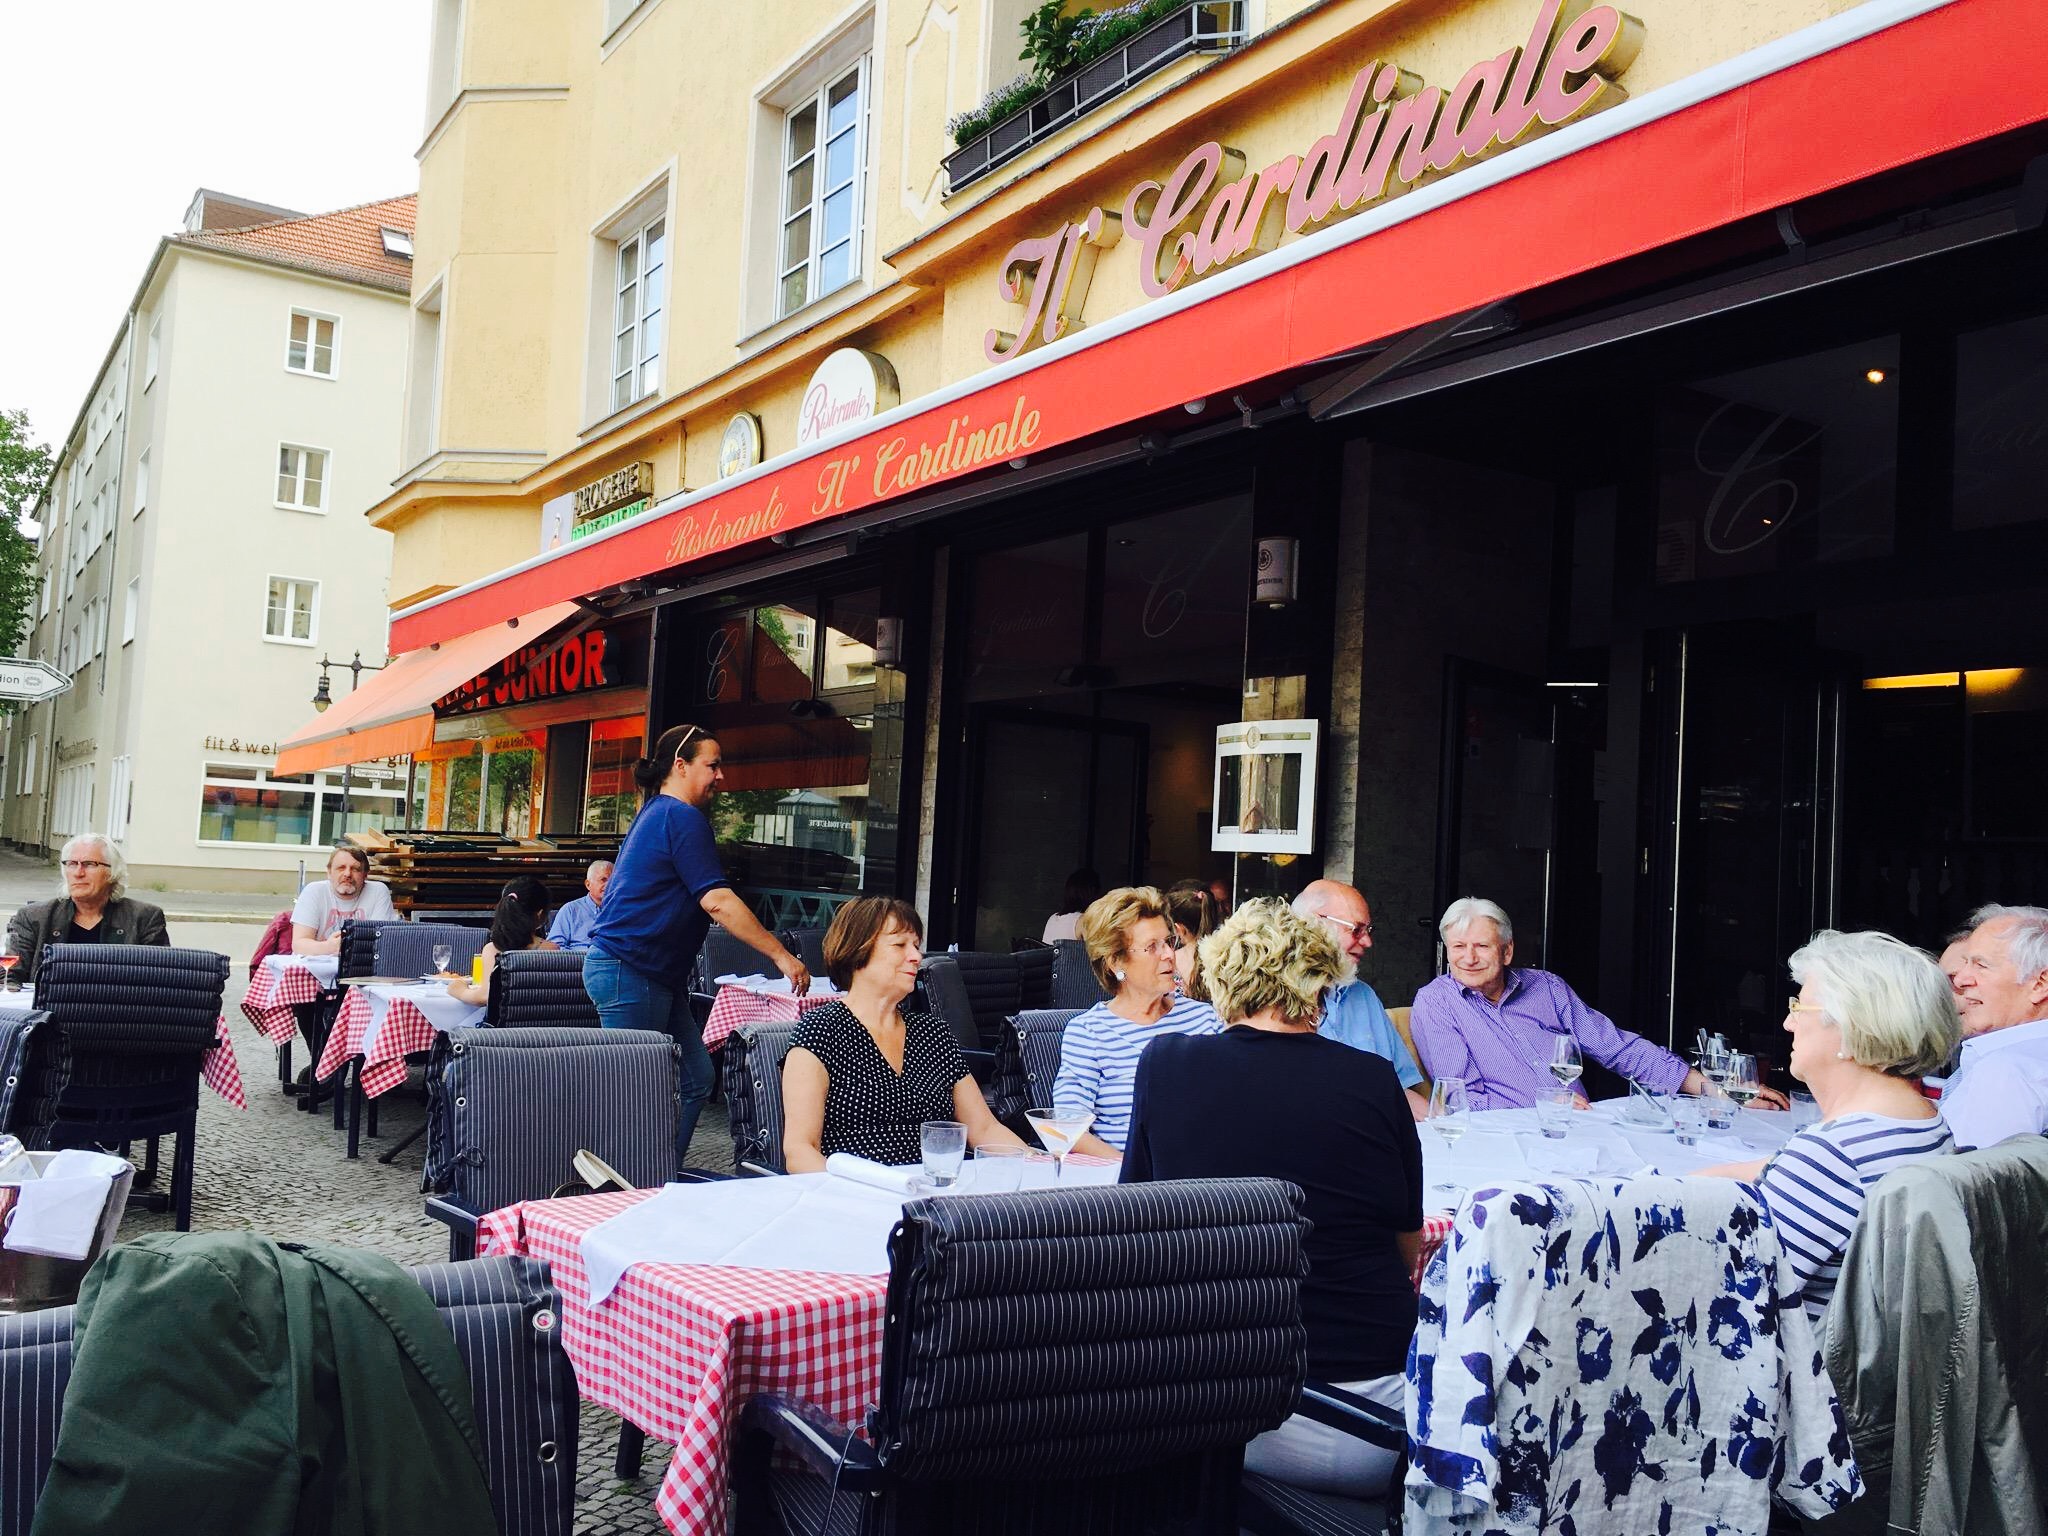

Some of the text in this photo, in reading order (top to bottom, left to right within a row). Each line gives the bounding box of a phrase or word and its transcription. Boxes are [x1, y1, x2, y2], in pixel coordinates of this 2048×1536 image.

[1122, 0, 1622, 300] Cardinale
[800, 382, 871, 442] Ristorante
[573, 463, 639, 517] DROGERIE
[666, 487, 786, 564] Ristorante
[873, 395, 1041, 498] Cardinale
[494, 630, 607, 704] JUNIOR
[204, 735, 225, 751] fit
[229, 737, 240, 752] &
